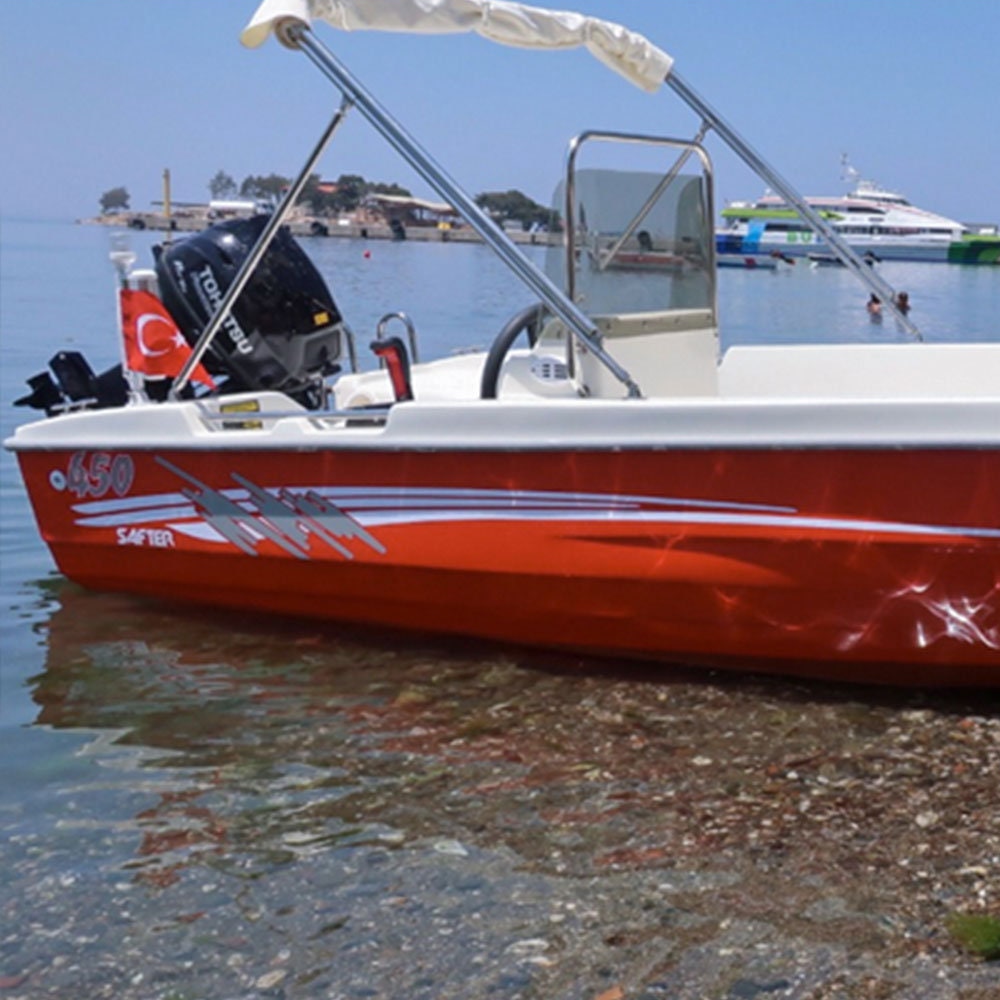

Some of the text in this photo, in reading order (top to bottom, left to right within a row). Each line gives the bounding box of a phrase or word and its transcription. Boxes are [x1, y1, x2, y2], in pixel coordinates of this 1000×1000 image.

[200, 264, 253, 354] TOHTSU
[67, 450, 134, 498] 450
[116, 527, 176, 548] SAFTER
